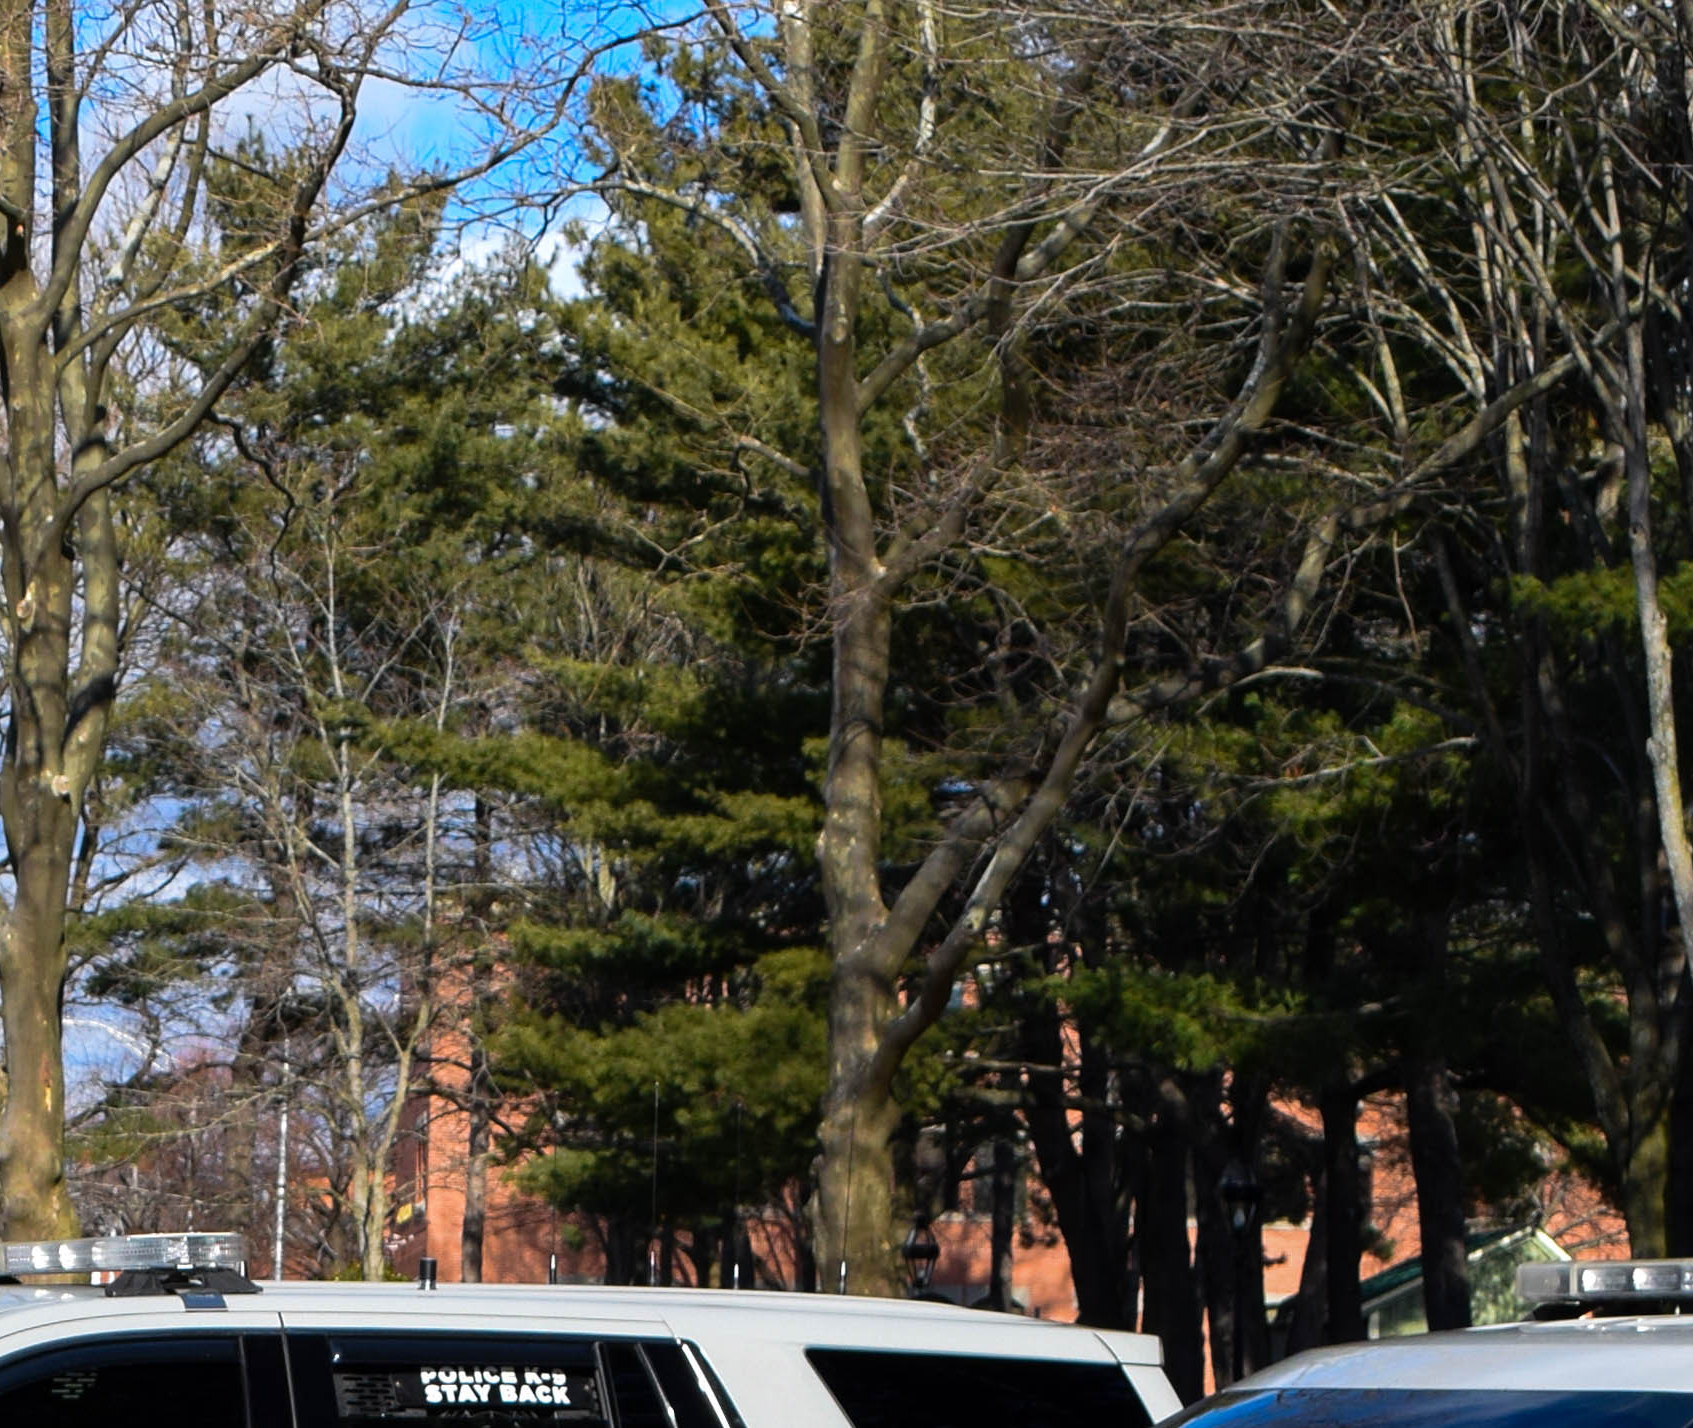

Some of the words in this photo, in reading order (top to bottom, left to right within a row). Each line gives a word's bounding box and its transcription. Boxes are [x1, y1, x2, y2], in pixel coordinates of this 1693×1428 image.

[420, 1366, 517, 1385] POLICE
[424, 1384, 491, 1404] STAY
[499, 1384, 572, 1405] BACK
